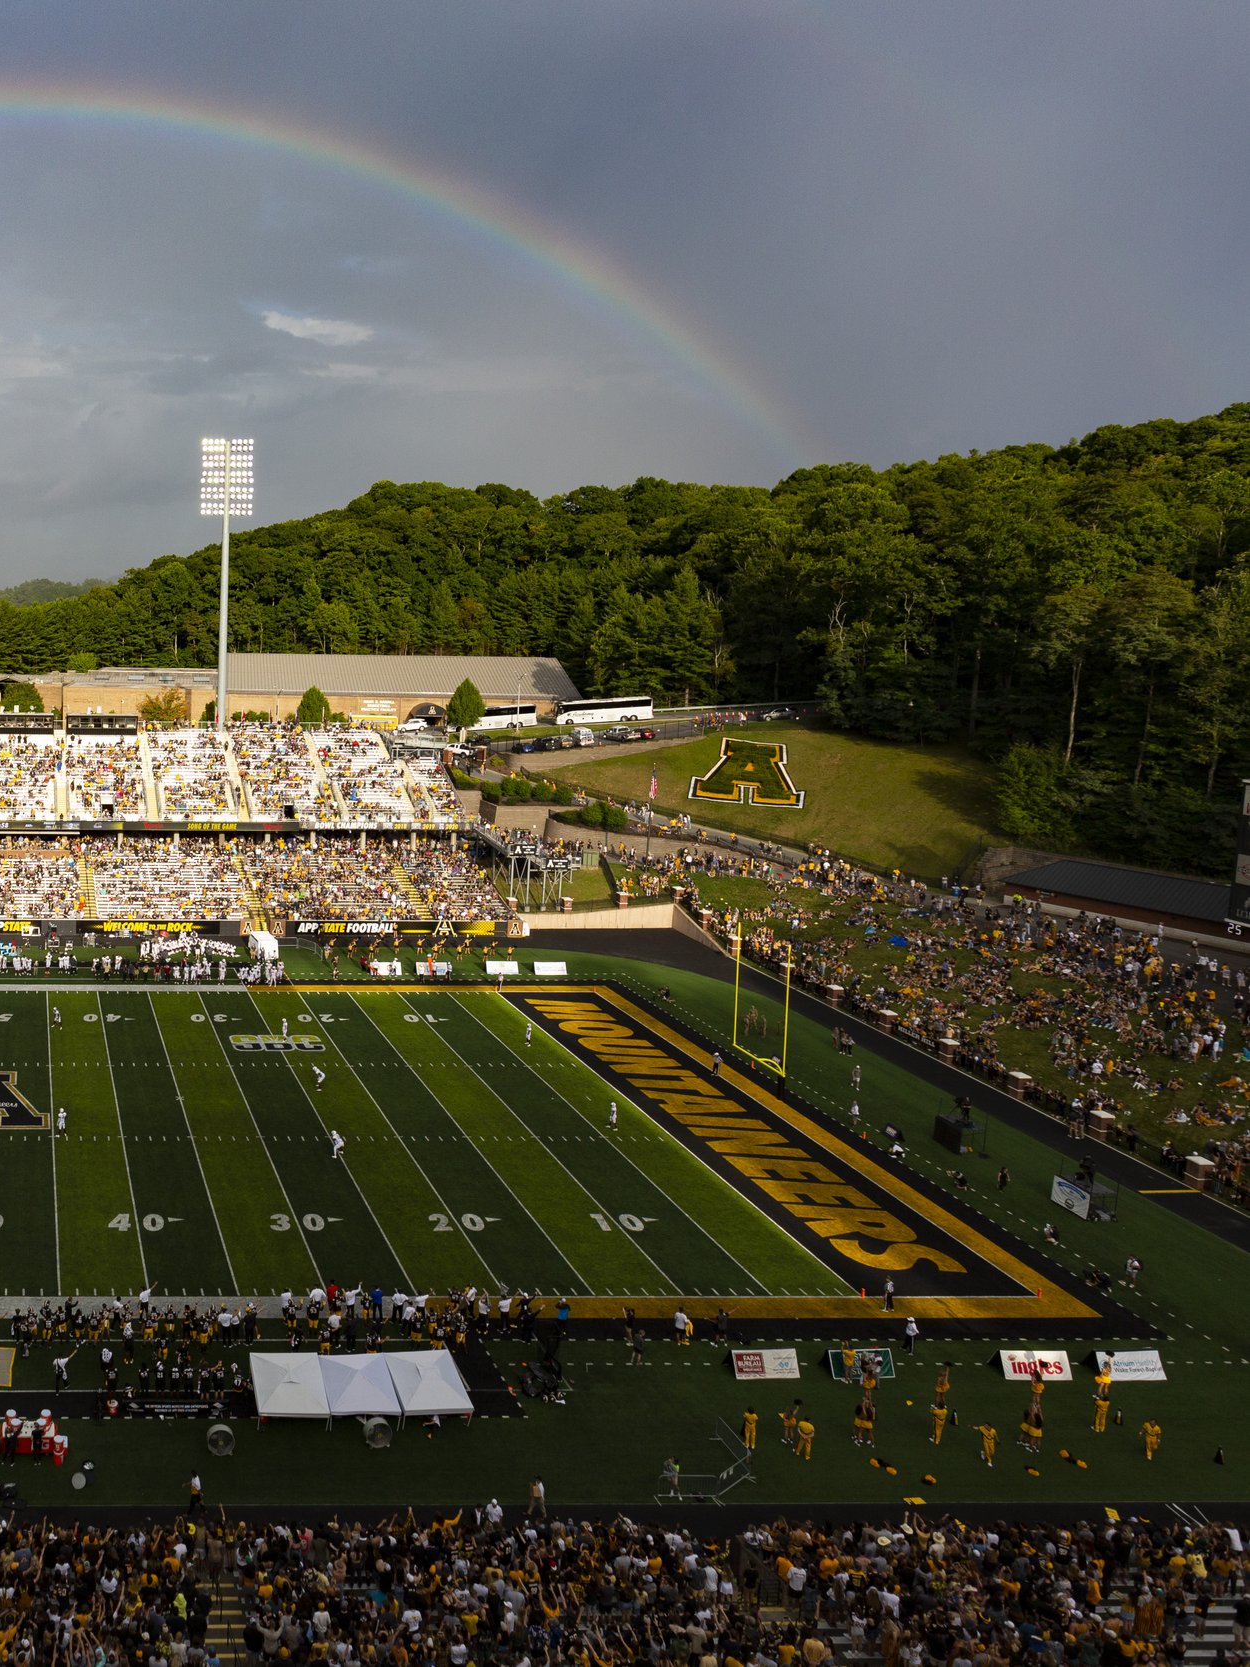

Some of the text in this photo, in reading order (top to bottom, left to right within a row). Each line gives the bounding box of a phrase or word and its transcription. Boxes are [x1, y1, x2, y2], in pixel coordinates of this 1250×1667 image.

[3, 921, 31, 932] STATE
[103, 922, 148, 931] WELCOME
[167, 922, 193, 931] ROCK
[243, 921, 253, 935] A
[272, 922, 282, 935] A
[297, 923, 318, 932] APP
[346, 923, 394, 933] FOOTBALL
[510, 922, 521, 935] A
[1227, 922, 1242, 936] 25
[83, 1013, 122, 1022] 40
[190, 1014, 228, 1022] 30
[297, 1014, 335, 1022] 20
[403, 1014, 440, 1023] 10
[229, 1034, 326, 1052] SBC
[524, 998, 968, 1275] MOUNTAINEERS
[108, 1213, 165, 1232] 40
[269, 1213, 325, 1232] 30
[428, 1213, 484, 1232] 20
[589, 1213, 645, 1232] 10
